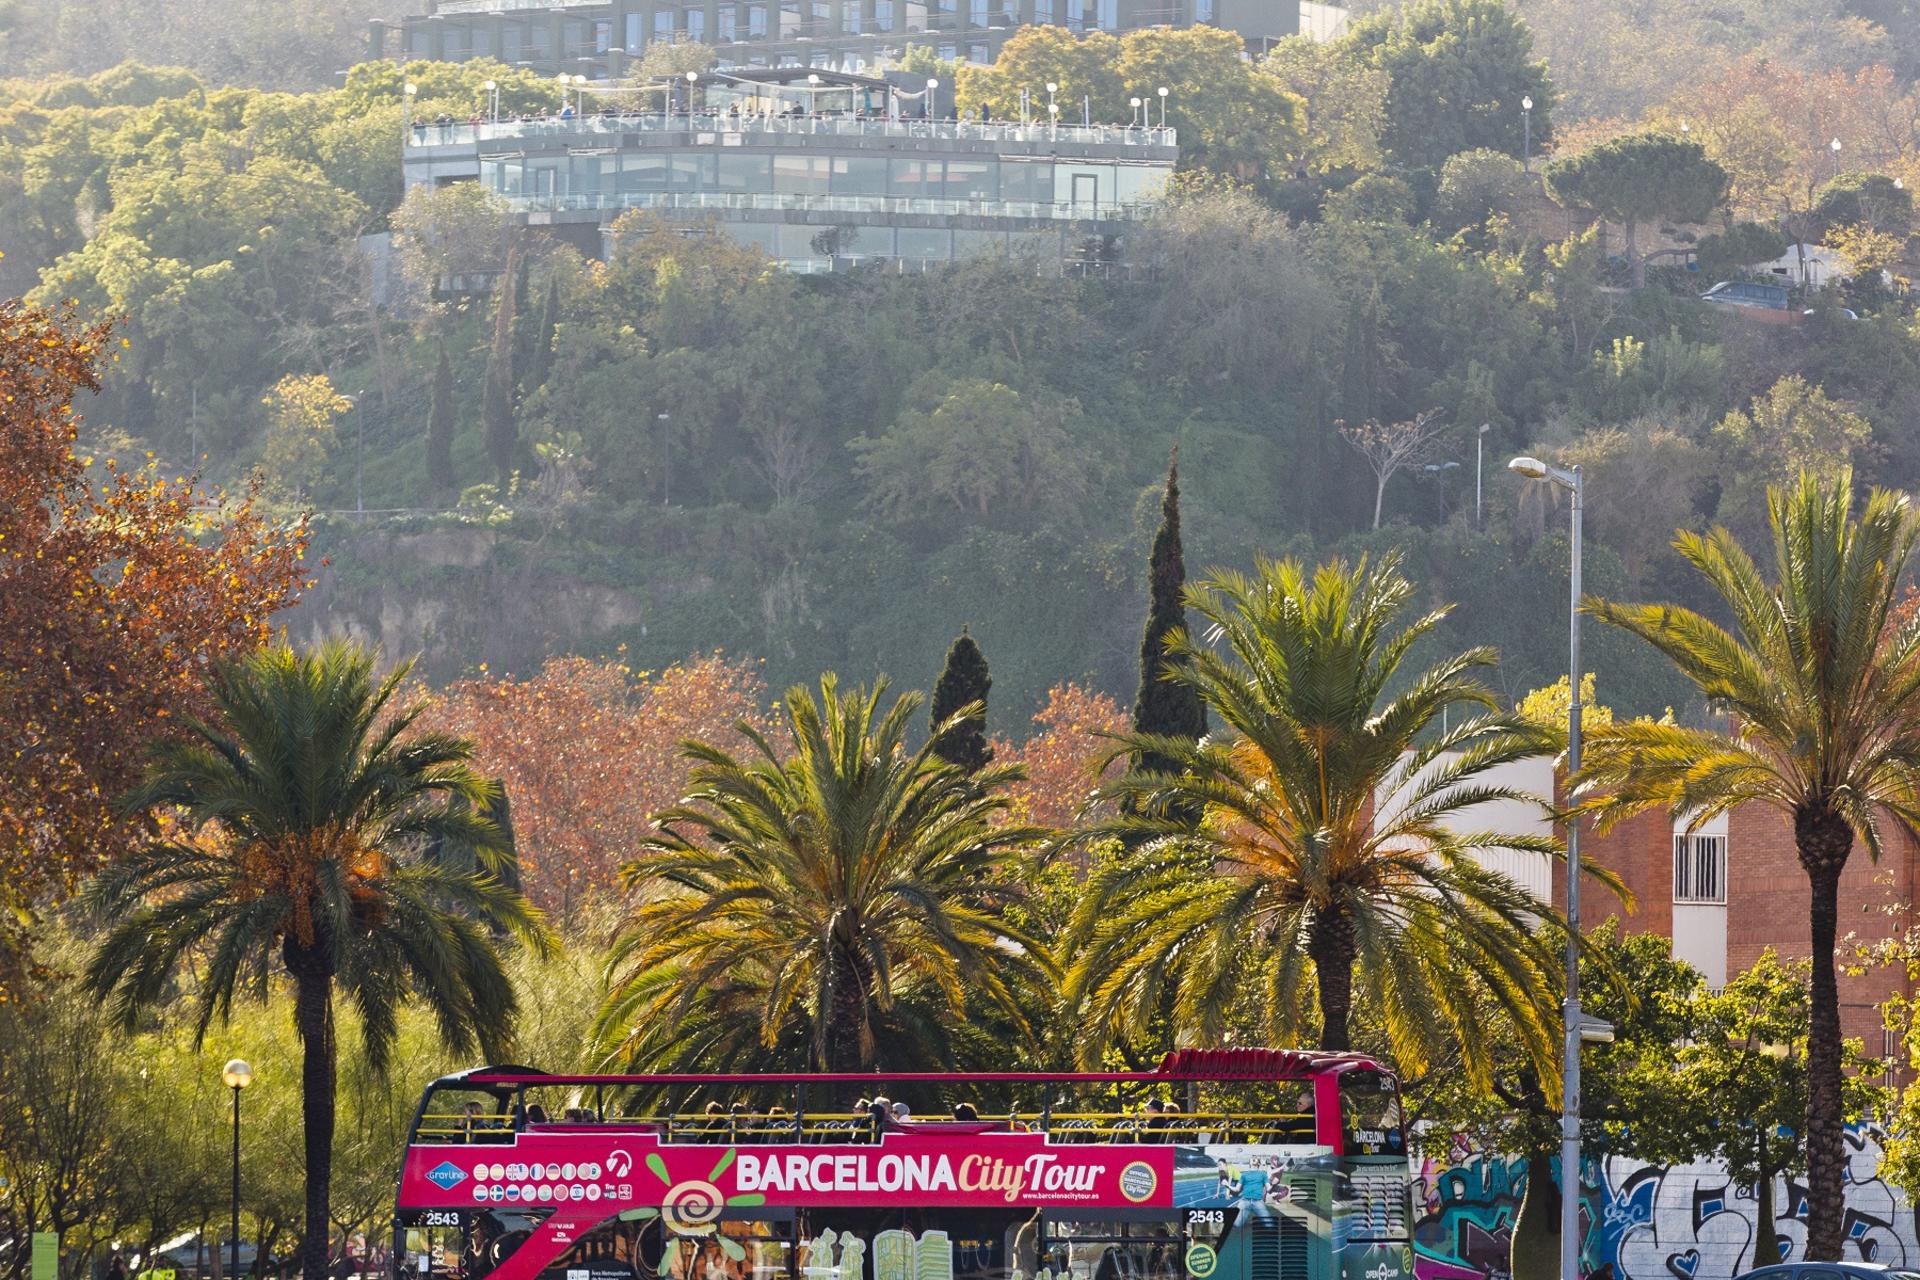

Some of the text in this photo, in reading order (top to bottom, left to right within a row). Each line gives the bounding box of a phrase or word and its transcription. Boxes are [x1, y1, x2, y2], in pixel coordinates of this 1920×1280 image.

[1355, 1130, 1386, 1144] BARCELONA
[736, 1153, 1106, 1202] BARCELONA City Tour
[1022, 1192, 1099, 1201] www.barcelonacitytour.es
[426, 1212, 459, 1225] 2543
[1189, 1211, 1224, 1223] 2543
[1365, 1269, 1399, 1279] OPEN CAMP
